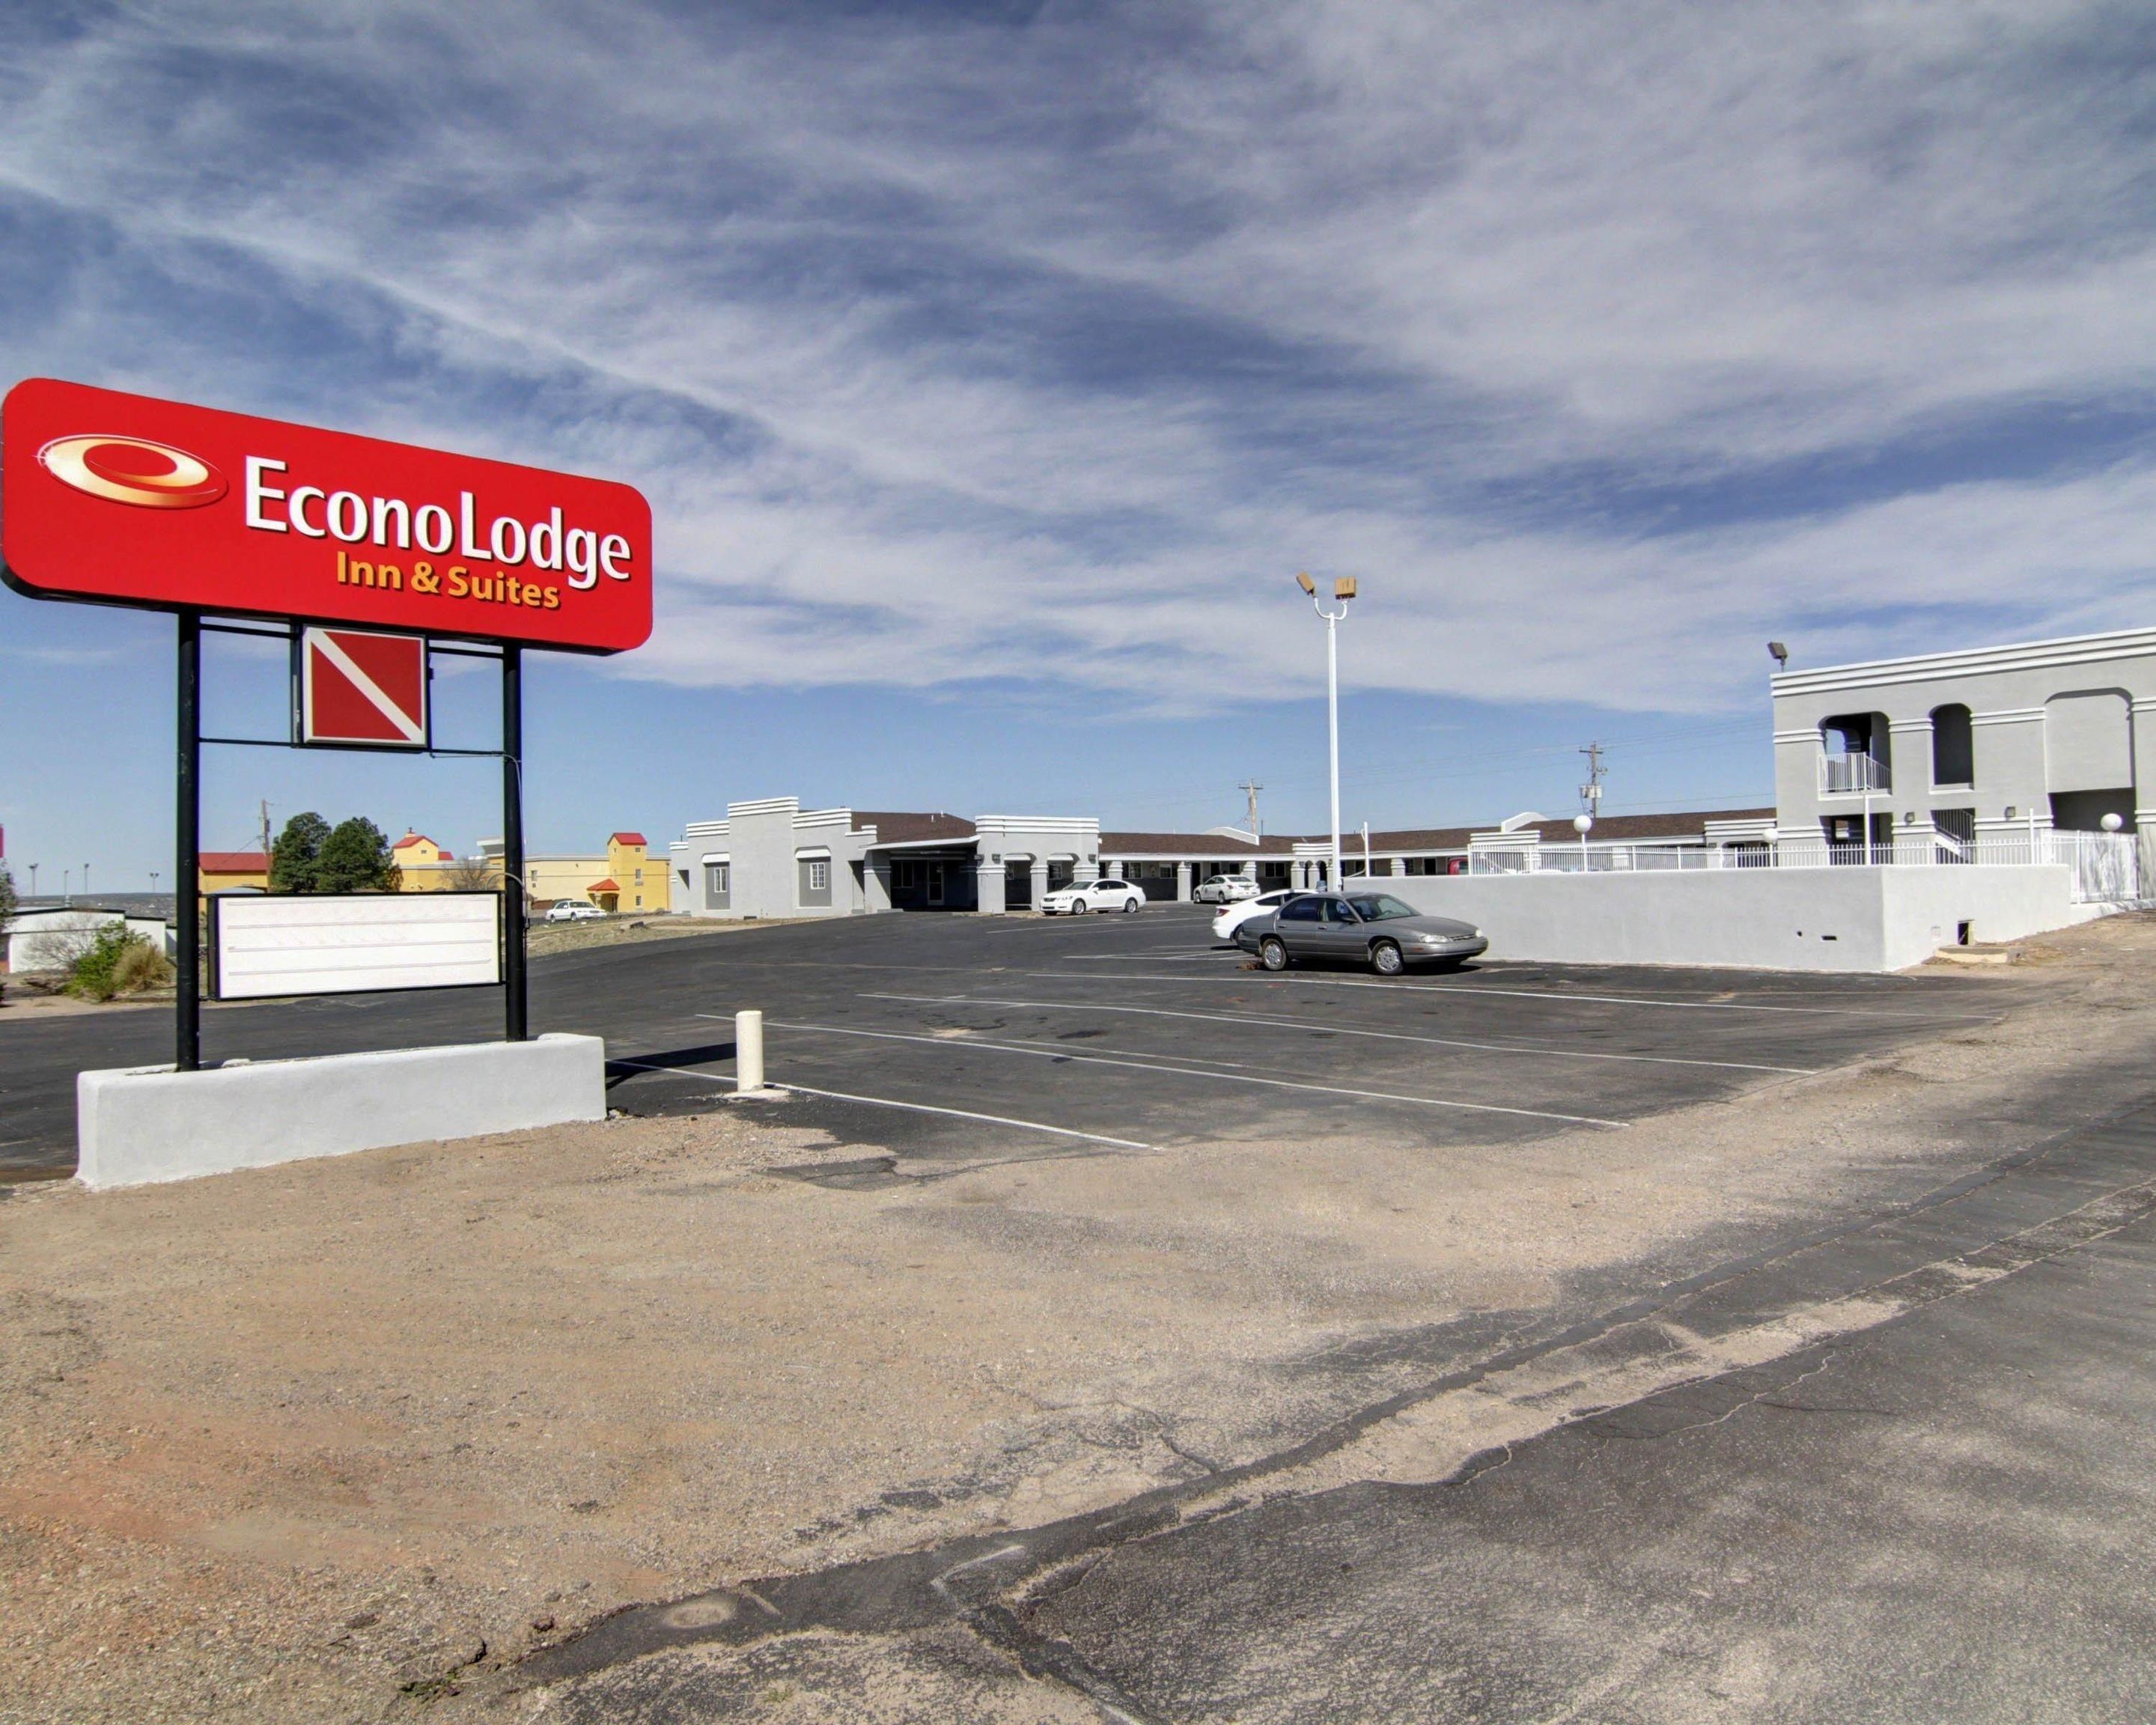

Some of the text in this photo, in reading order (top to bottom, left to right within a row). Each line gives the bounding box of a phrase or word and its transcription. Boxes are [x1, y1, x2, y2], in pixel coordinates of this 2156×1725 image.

[245, 455, 631, 589] EconoLodge
[337, 551, 560, 609] Inn & Suites
